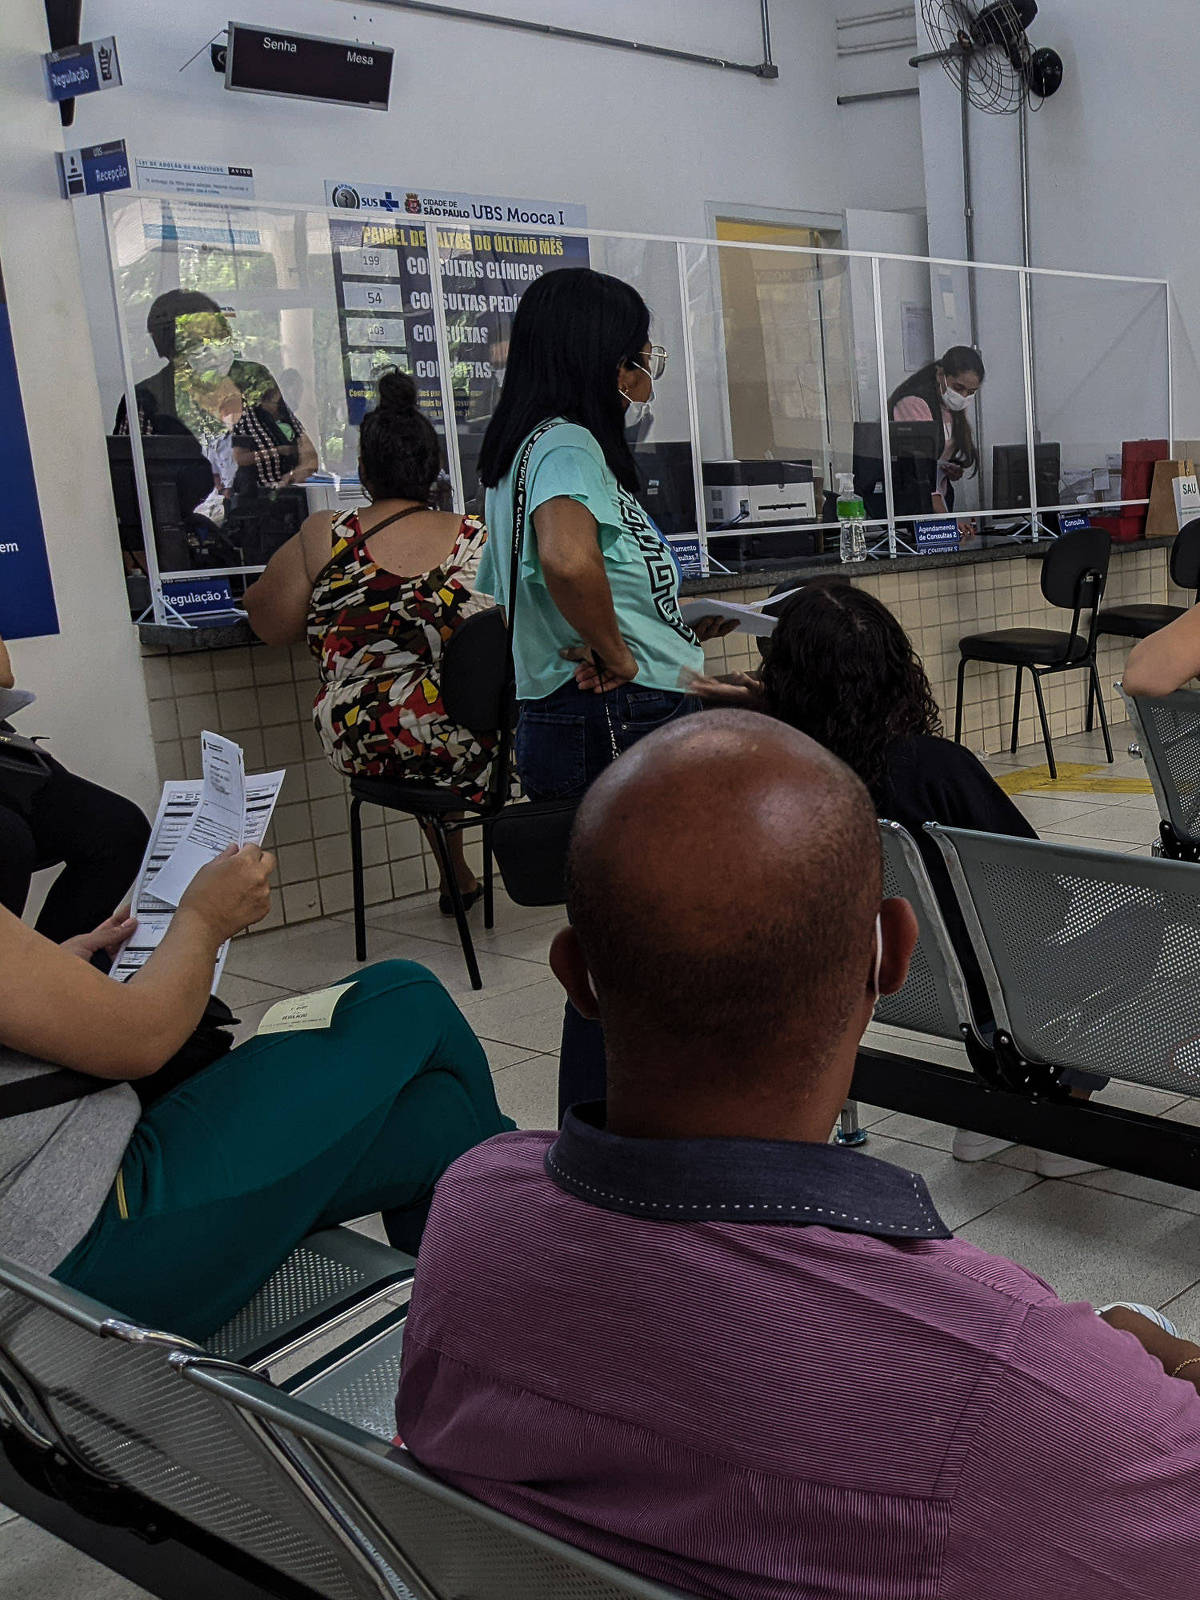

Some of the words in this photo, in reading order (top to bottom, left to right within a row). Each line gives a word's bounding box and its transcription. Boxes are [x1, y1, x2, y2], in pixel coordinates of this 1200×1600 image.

[263, 37, 297, 53] Senha
[347, 51, 374, 65] Mesa
[52, 67, 90, 88] Regulação
[95, 164, 127, 182] Recepção
[231, 168, 252, 176] AVISO
[361, 197, 379, 208] SUS
[423, 198, 447, 207] CIDADE
[424, 205, 442, 216] SÃO
[443, 208, 470, 219] PAULO
[472, 204, 503, 221] UBS
[507, 208, 555, 225] Mooca
[558, 210, 565, 225] I
[362, 226, 408, 247] PAINEL
[410, 229, 426, 247] DE
[474, 235, 492, 251] DO
[494, 233, 537, 255] ÚLTIMO
[540, 239, 564, 256] MÊS
[363, 256, 380, 266] 199
[486, 259, 544, 282] CLÍNICAS
[368, 292, 382, 304] 54
[1182, 482, 1197, 496] SAU
[918, 524, 956, 534] Agendamento
[1064, 518, 1085, 527] Consulta
[926, 530, 952, 540] Consultas
[163, 590, 221, 607] Regulação
[223, 588, 231, 600] 1
